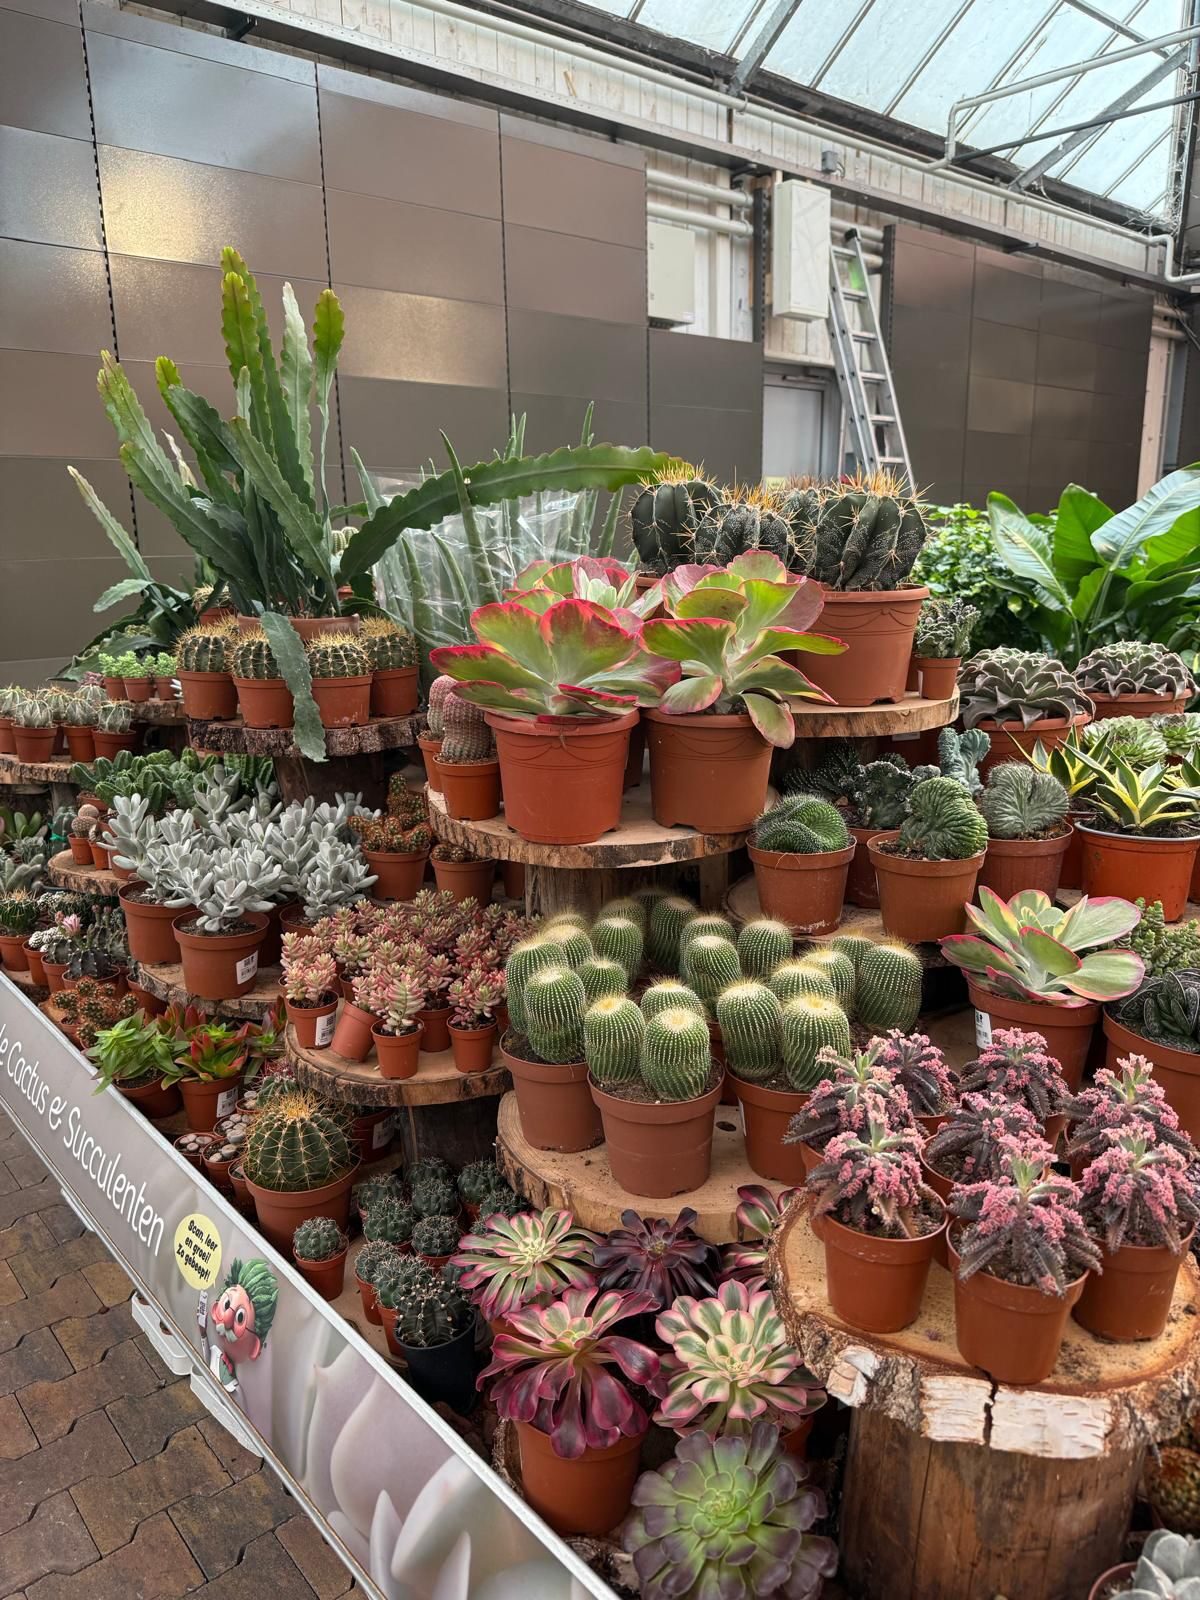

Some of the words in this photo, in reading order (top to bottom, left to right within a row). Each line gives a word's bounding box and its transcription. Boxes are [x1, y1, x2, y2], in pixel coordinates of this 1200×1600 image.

[7, 1041, 50, 1115] Cactus
[48, 1095, 68, 1130] &
[63, 1106, 165, 1257] Succulenten
[185, 1237, 193, 1249] en
[193, 1243, 211, 1264] groei!
[188, 1220, 204, 1243] Scan,
[204, 1234, 218, 1252] leer
[176, 1243, 184, 1258] Zo
[184, 1254, 211, 1282] gebeept!
